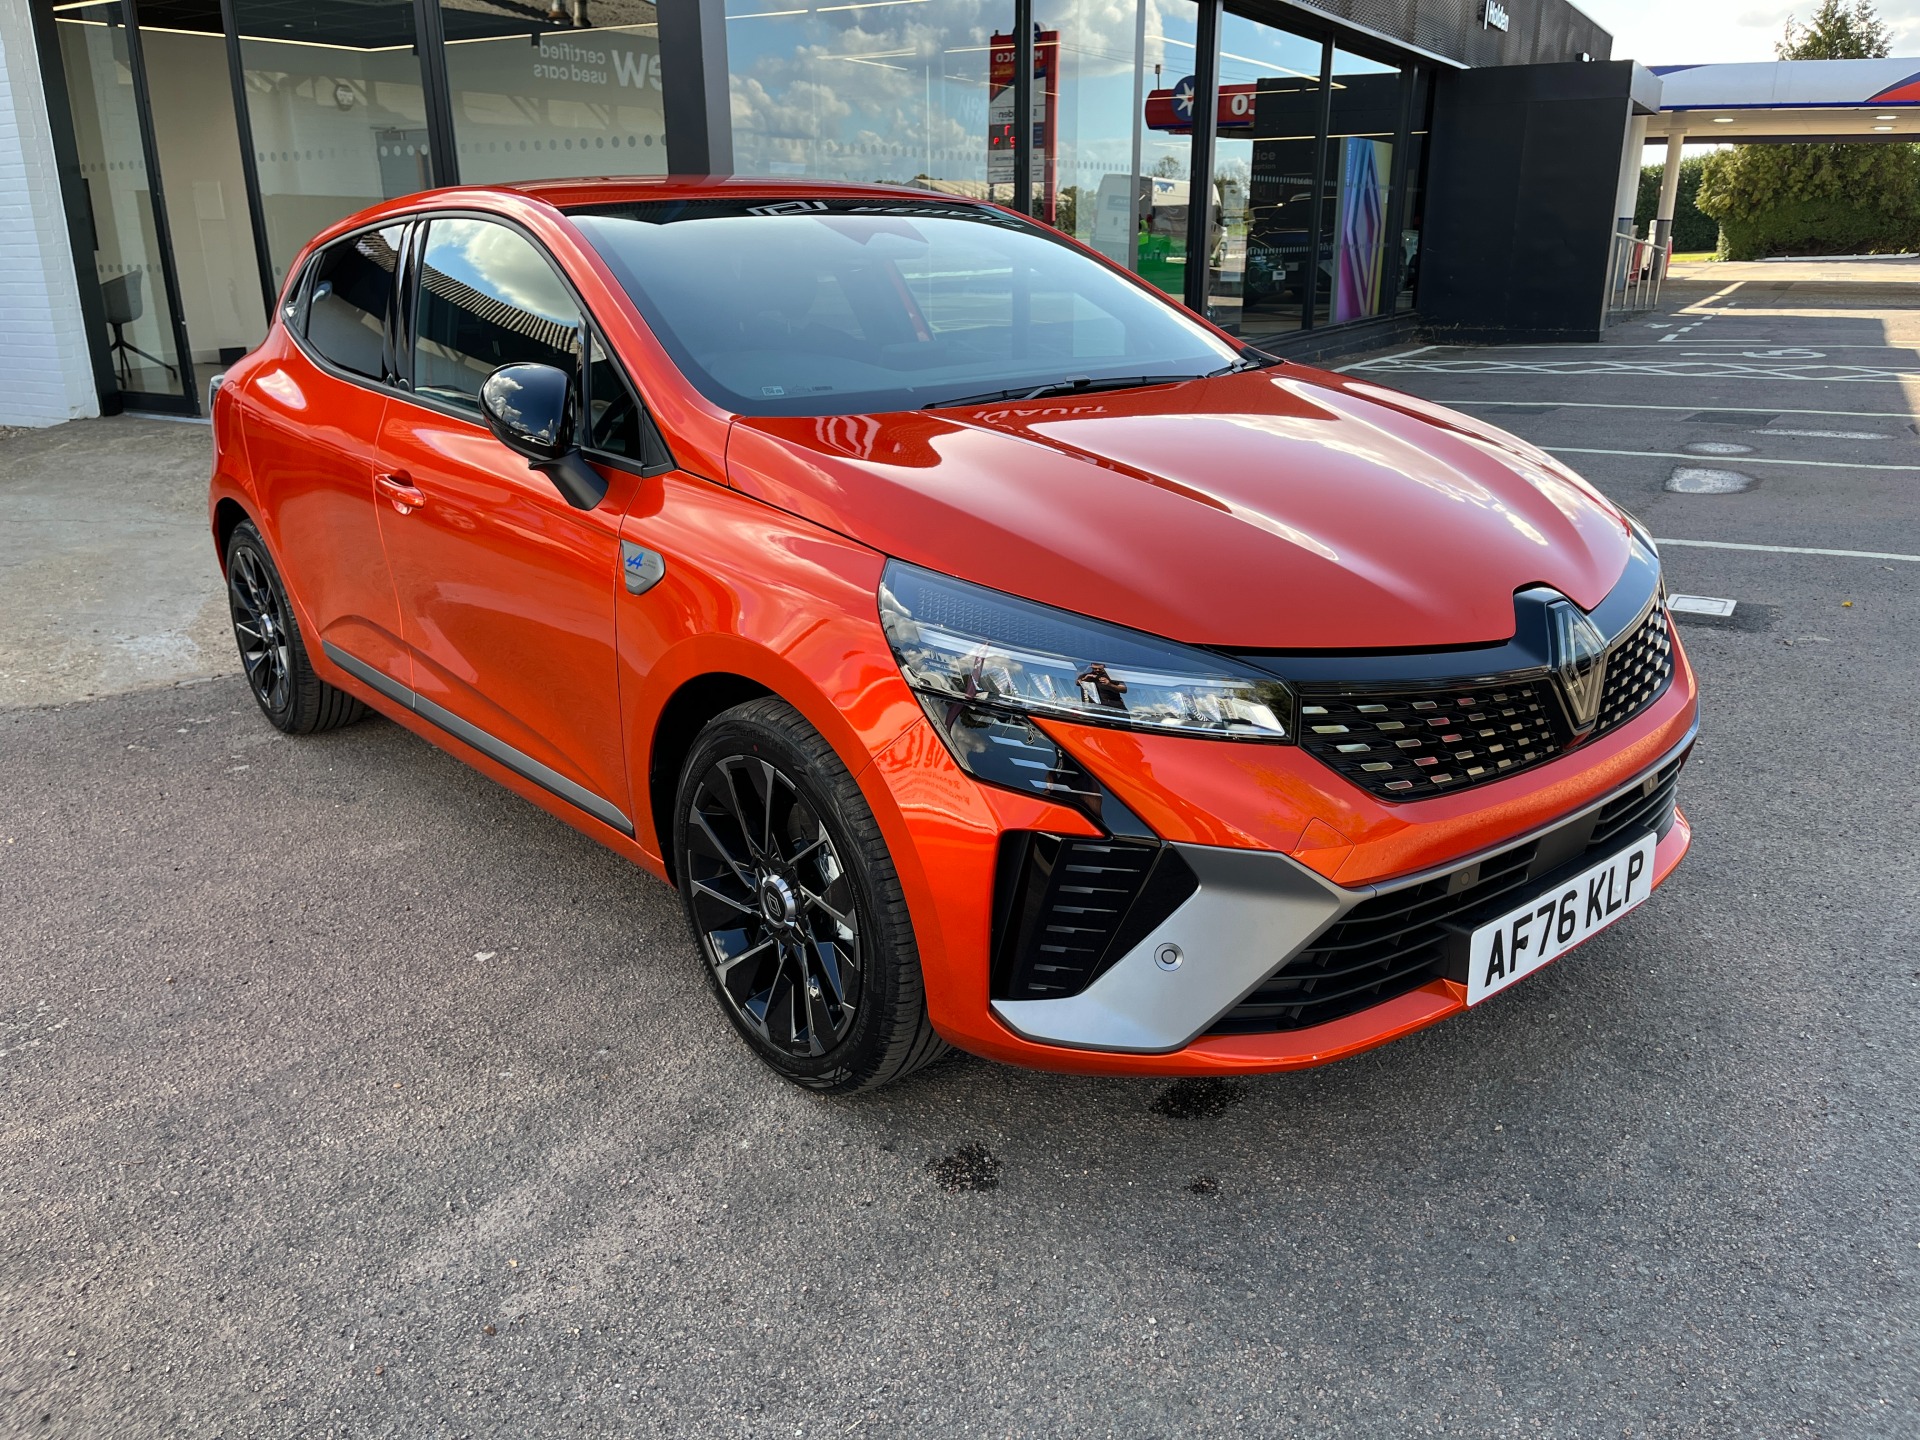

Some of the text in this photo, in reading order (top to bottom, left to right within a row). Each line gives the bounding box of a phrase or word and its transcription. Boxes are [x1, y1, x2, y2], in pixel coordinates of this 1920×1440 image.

[1487, 1, 1509, 32] Holden
[1484, 849, 1644, 988] AF76 KLP
